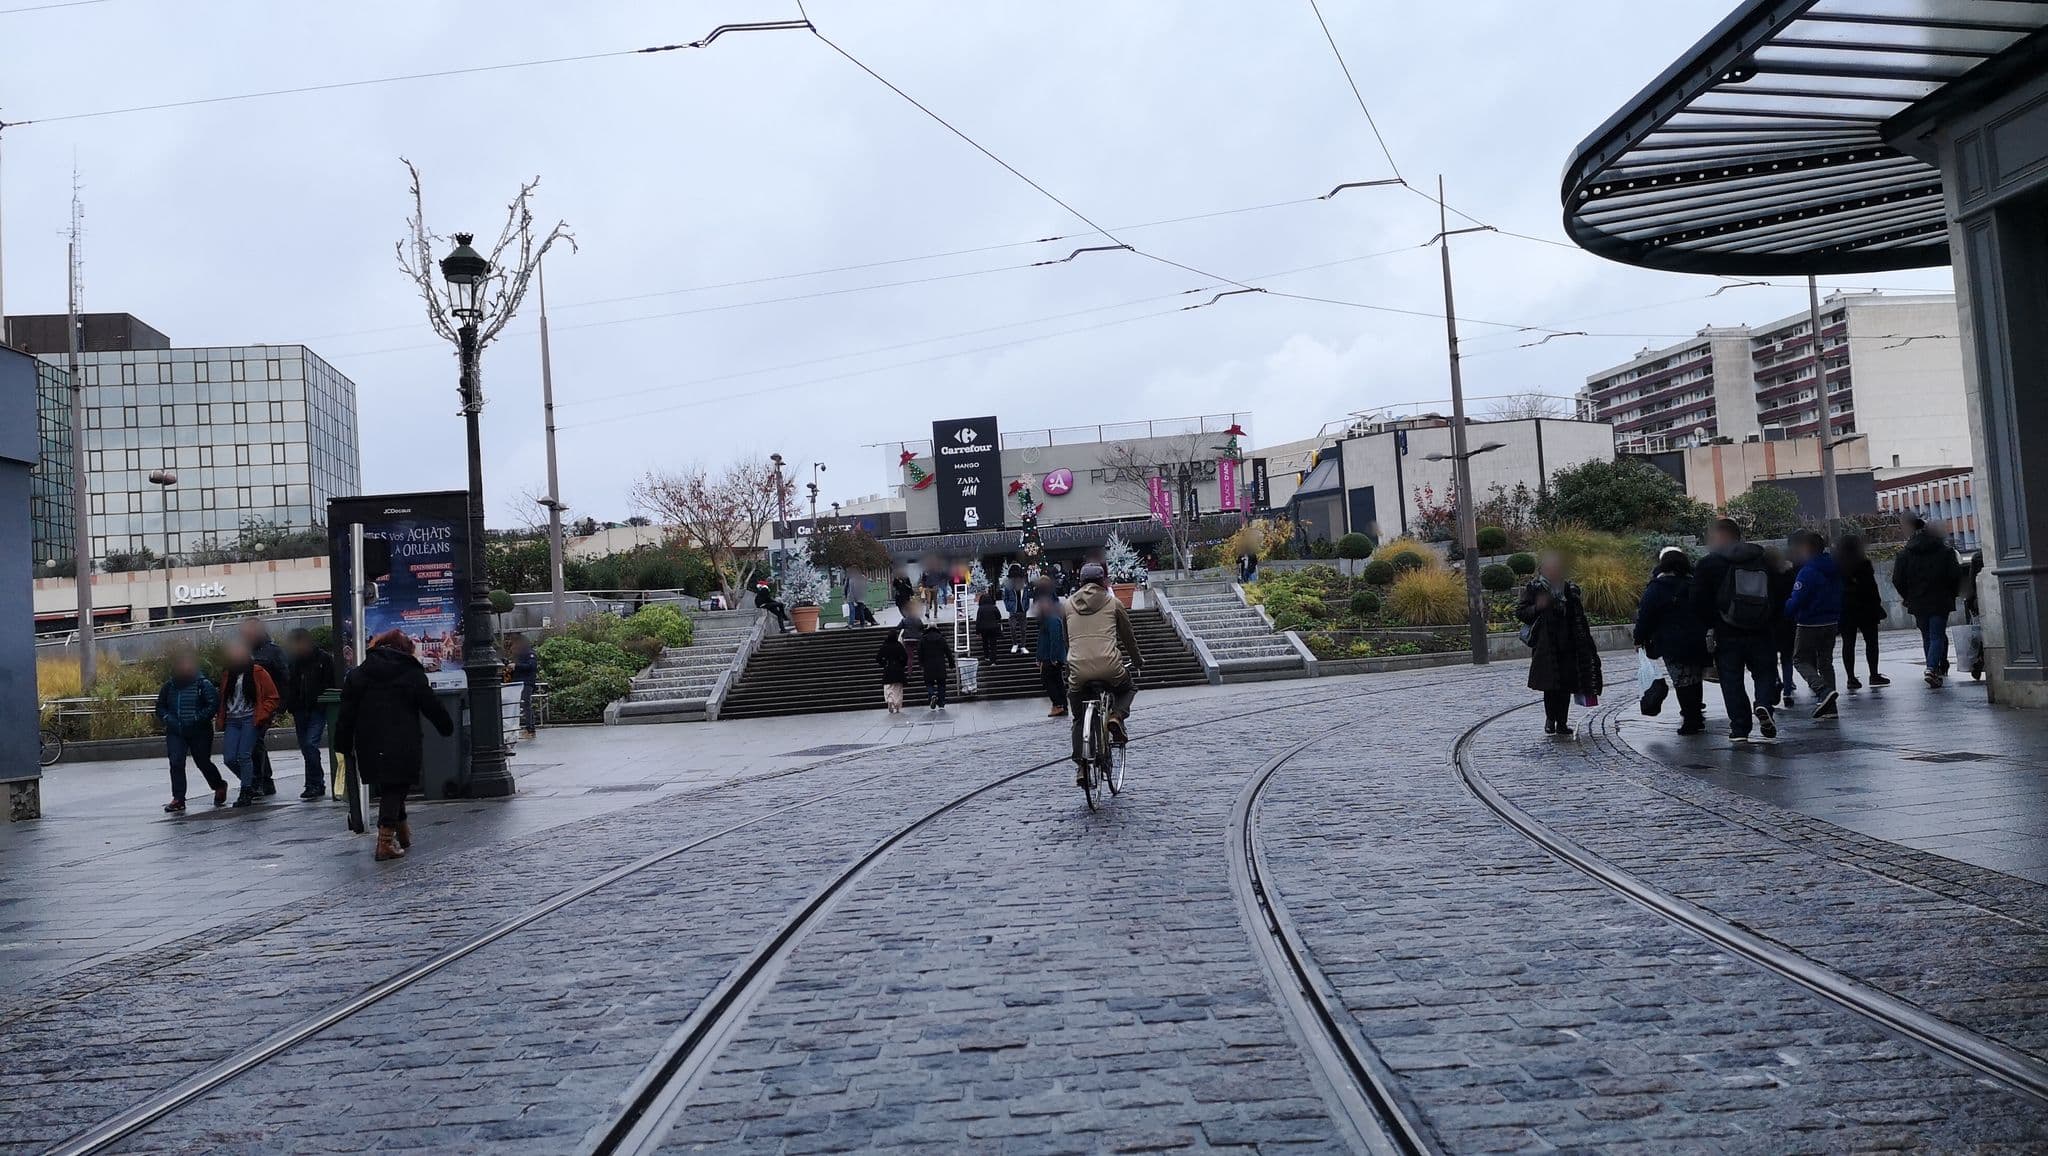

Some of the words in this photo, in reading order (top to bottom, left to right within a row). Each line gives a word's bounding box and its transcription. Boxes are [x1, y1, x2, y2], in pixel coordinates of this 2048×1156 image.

[941, 444, 993, 455] Carrefour
[954, 462, 980, 470] MANGO
[956, 476, 980, 485] ZARA
[1257, 465, 1265, 501] bienvenue
[407, 526, 451, 541] ACHATS
[402, 541, 450, 557] ORLÉANS
[174, 581, 227, 603] Quick
